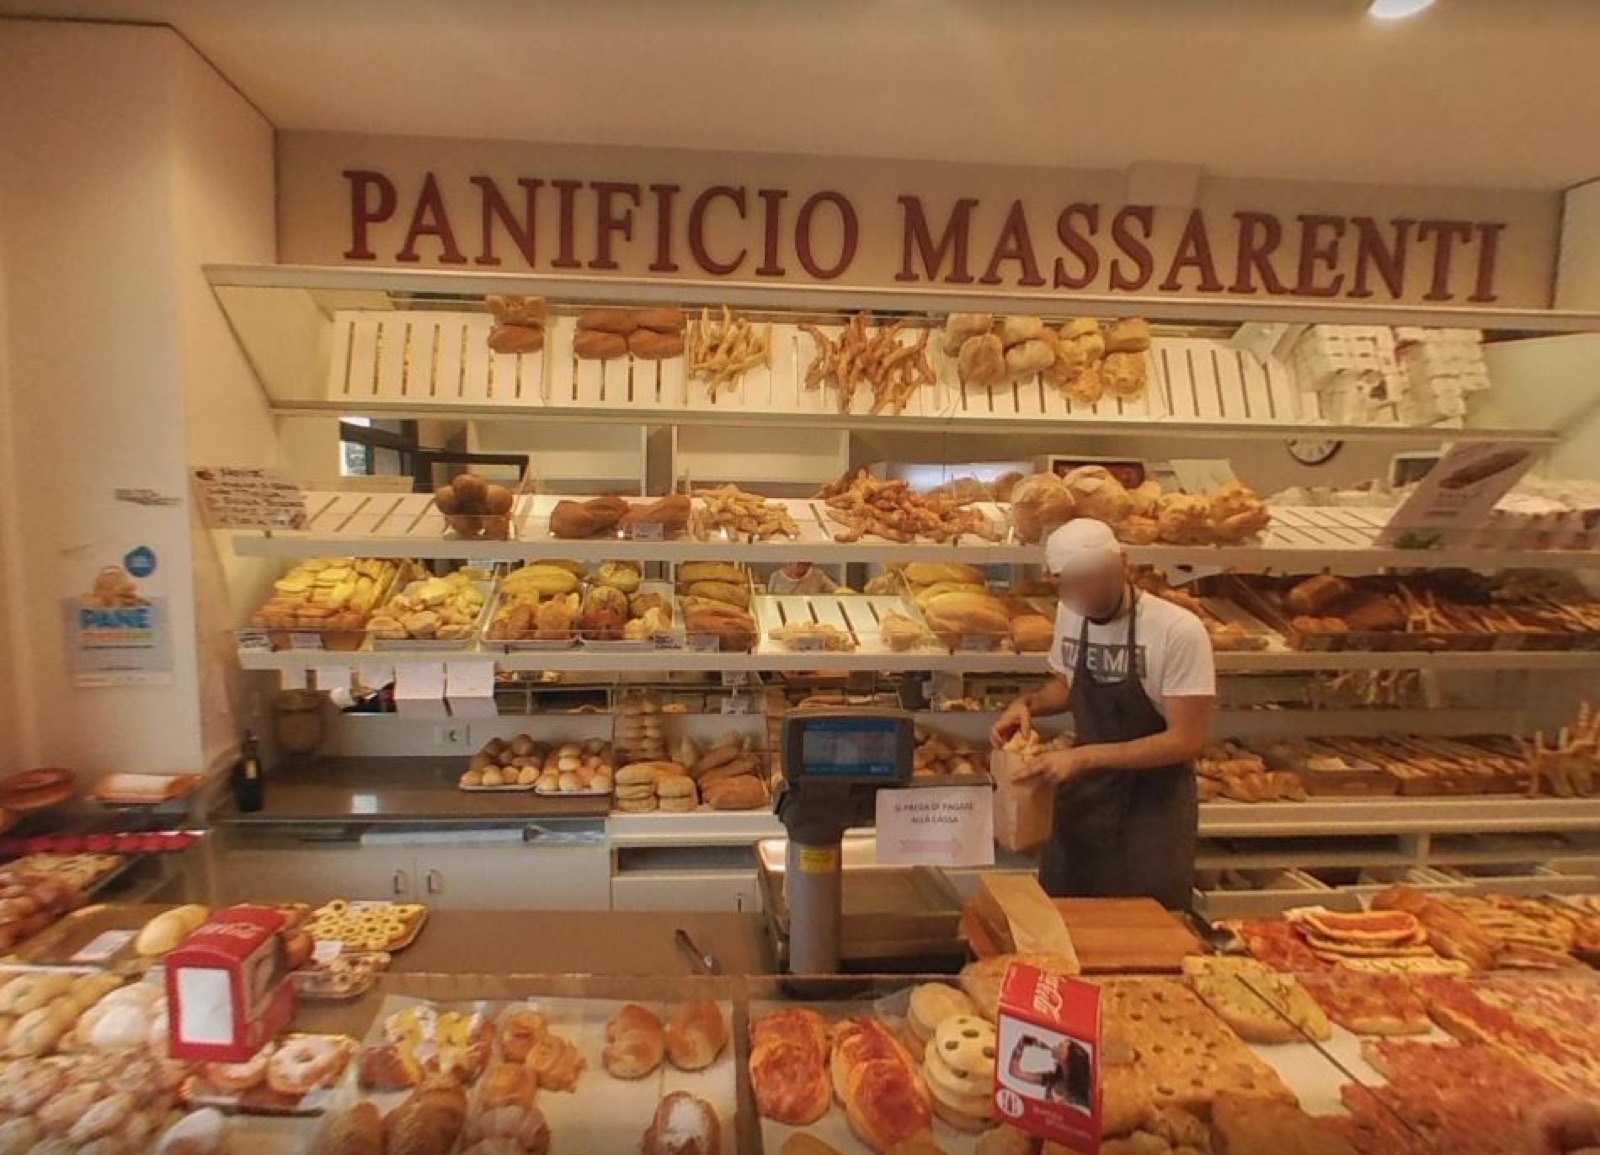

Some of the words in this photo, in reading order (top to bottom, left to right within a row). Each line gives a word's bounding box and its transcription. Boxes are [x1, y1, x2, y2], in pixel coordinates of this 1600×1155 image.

[342, 169, 859, 279] PANIFICIO
[894, 194, 1507, 300] MASSARENTI
[80, 607, 152, 629] PANE
[904, 803, 930, 811] PREGA
[942, 802, 973, 811] PAGARE
[910, 814, 930, 823] ALLA
[932, 814, 959, 823] CASSA
